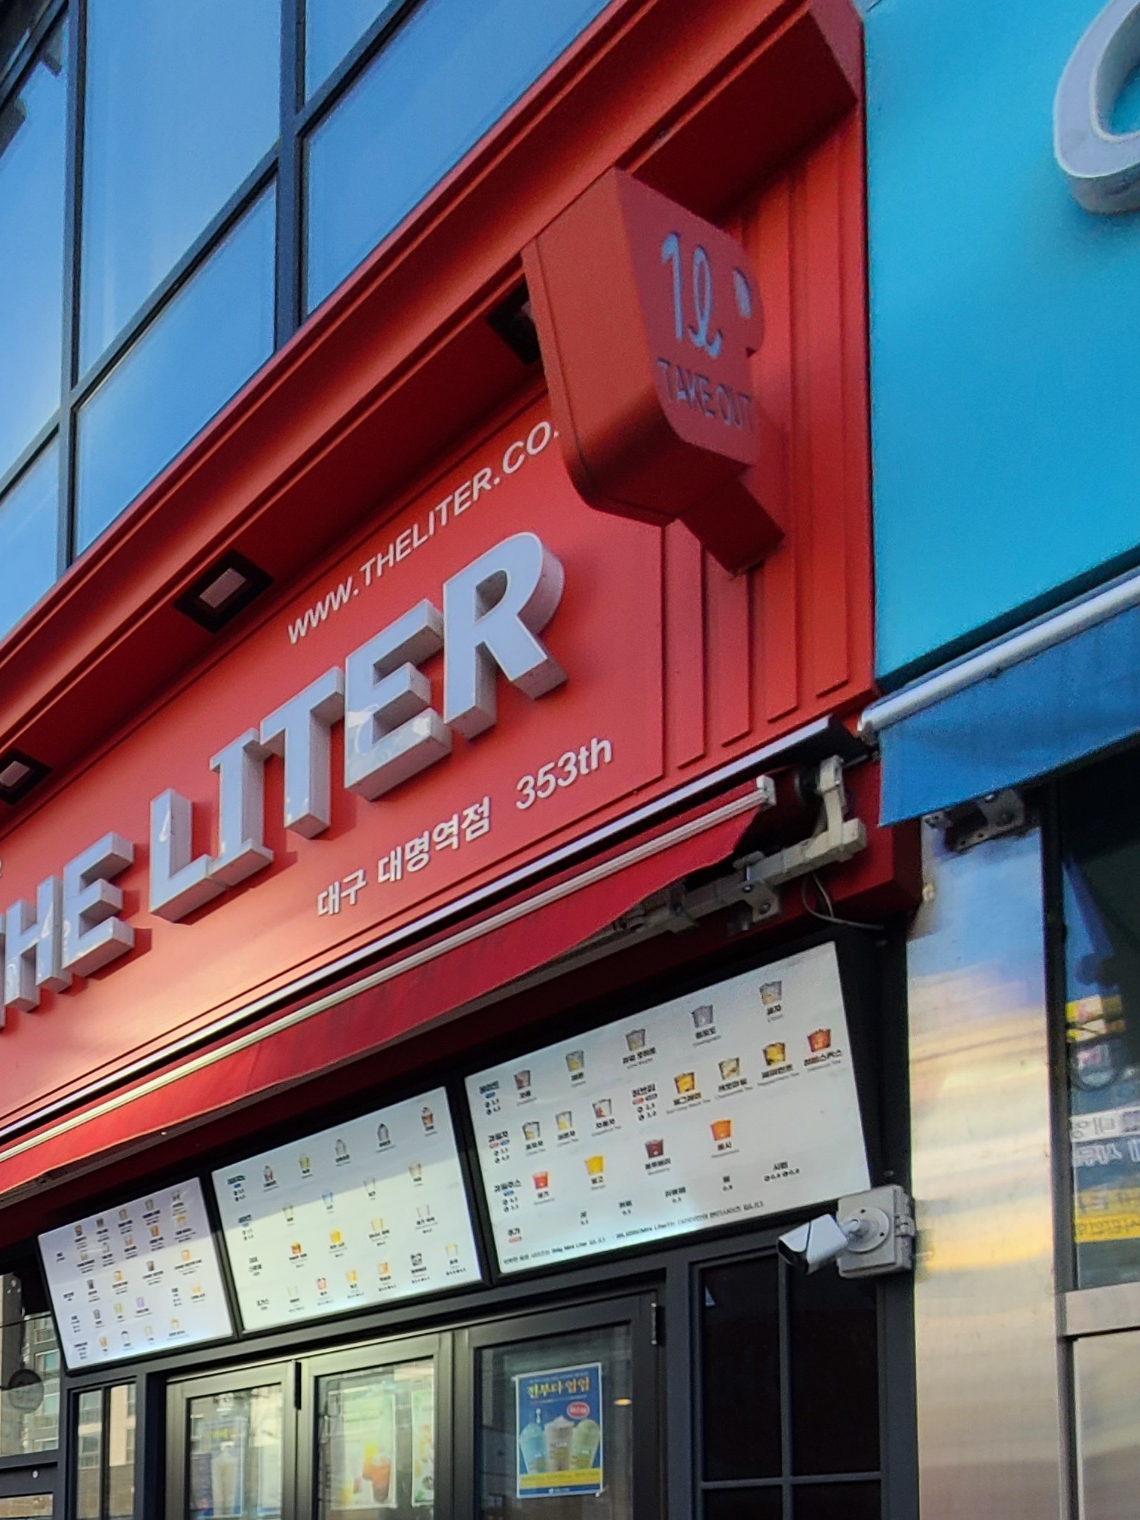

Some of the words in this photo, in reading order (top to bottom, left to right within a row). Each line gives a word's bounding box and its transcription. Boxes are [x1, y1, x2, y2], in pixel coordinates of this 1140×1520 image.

[657, 358, 715, 417] TAKE
[717, 384, 753, 430] OUT
[149, 531, 568, 924] LITER
[317, 868, 368, 917] 대구
[378, 796, 492, 883] 대명역점
[515, 737, 613, 811] 353th
